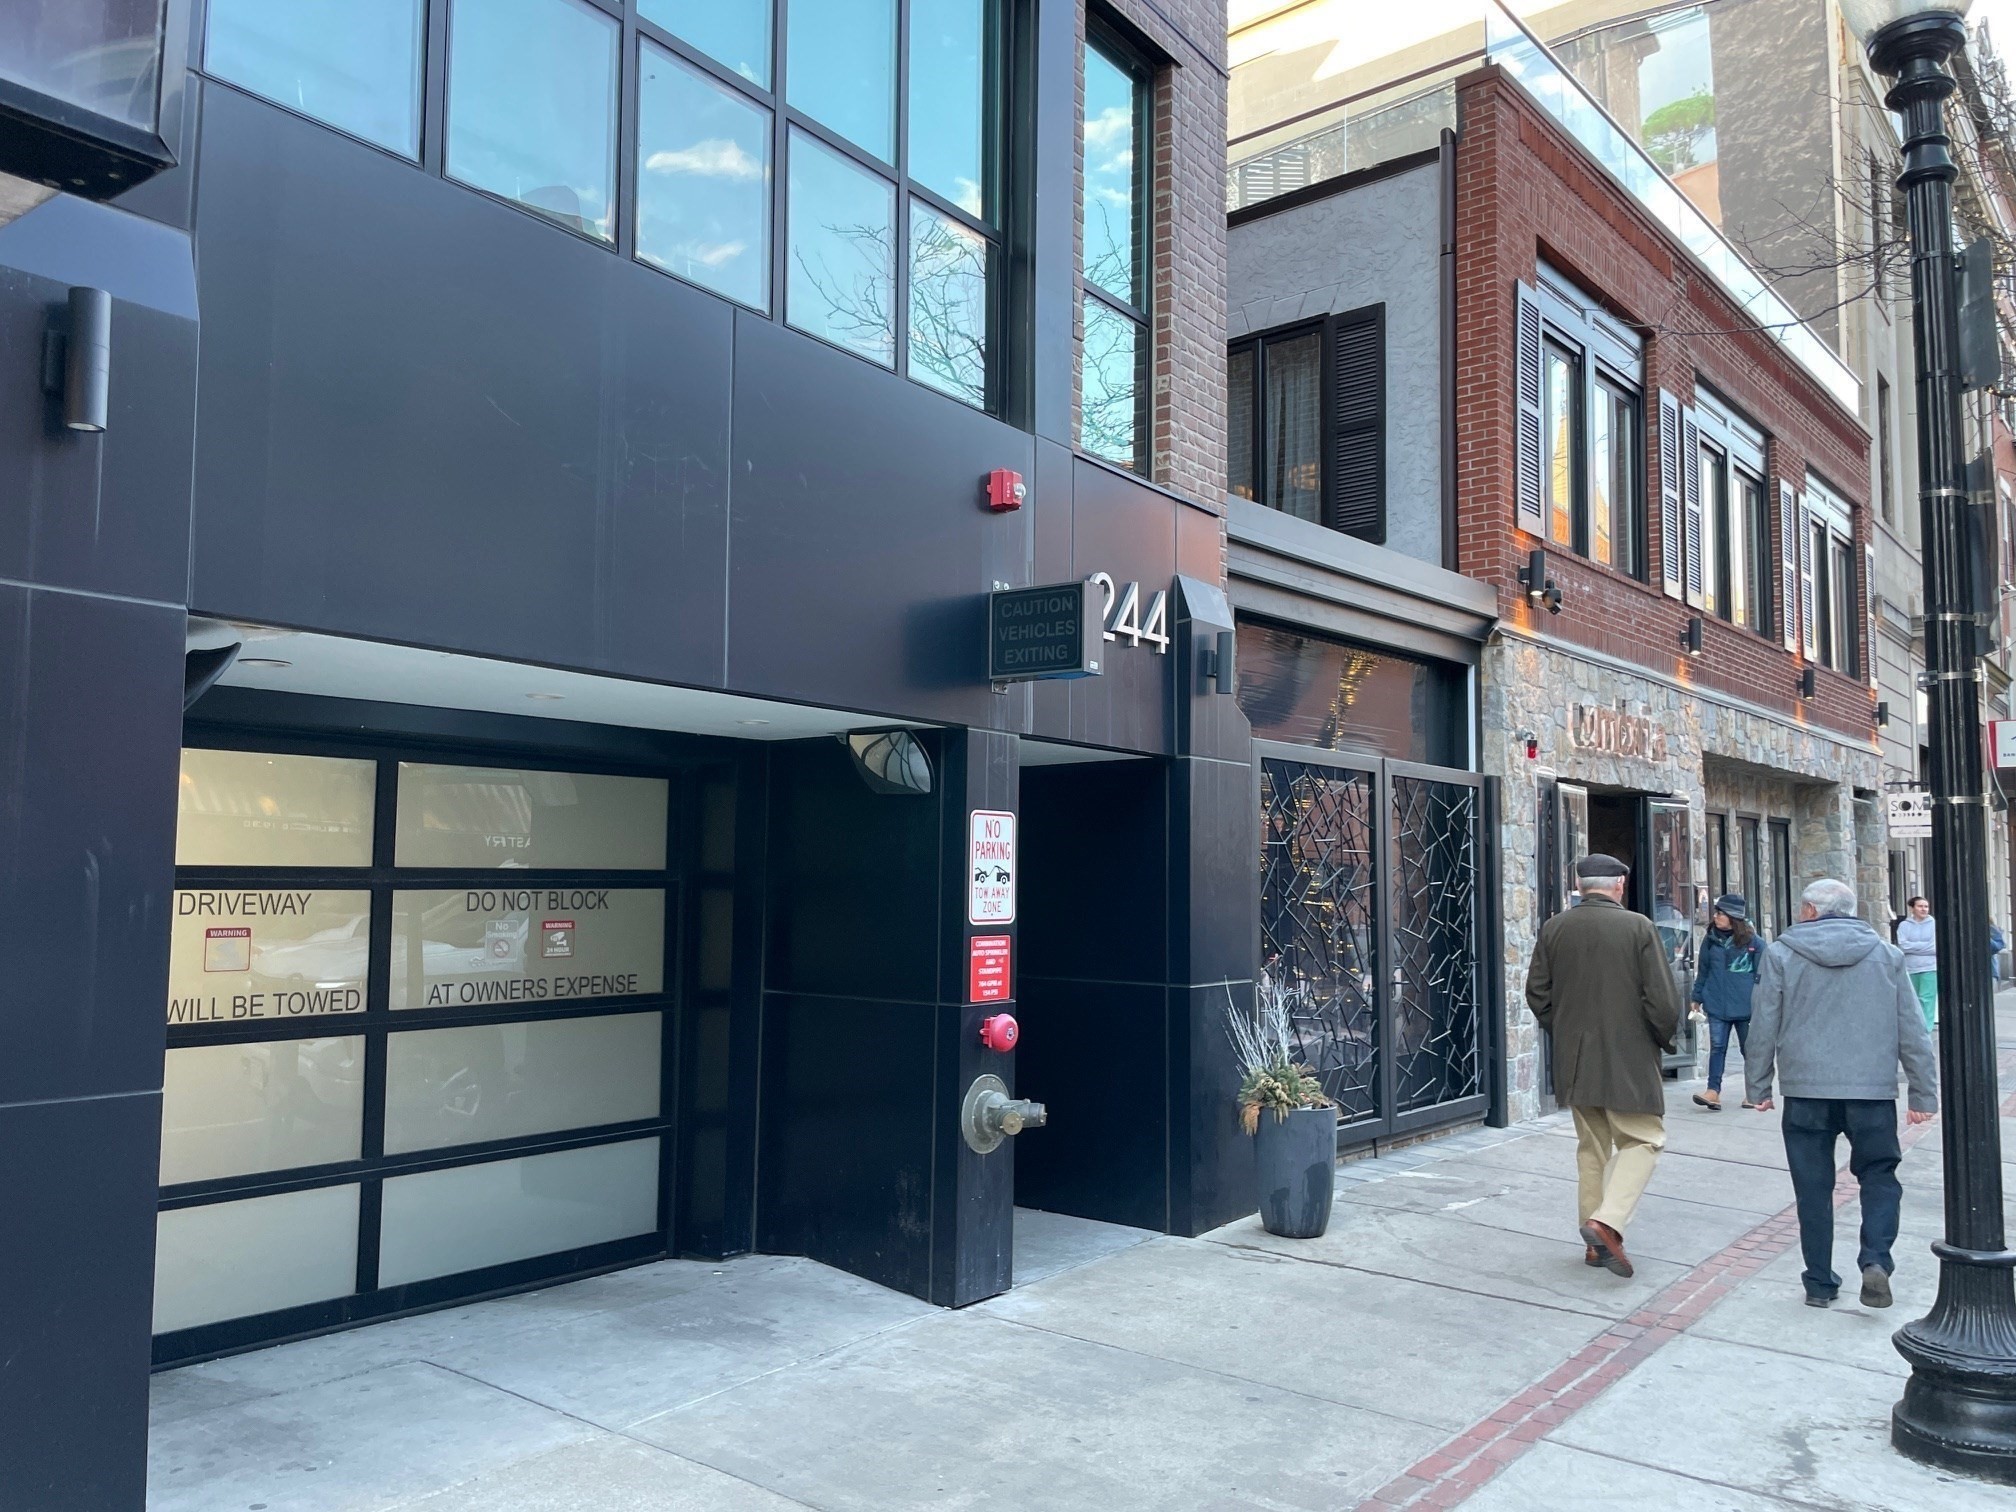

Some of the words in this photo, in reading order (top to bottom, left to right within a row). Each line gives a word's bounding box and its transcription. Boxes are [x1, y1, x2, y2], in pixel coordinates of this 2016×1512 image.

[1001, 596, 1074, 618] CAUTION
[1090, 571, 1169, 655] 244
[999, 619, 1076, 642] VEHICLES
[1004, 644, 1068, 665] EXITING
[985, 820, 1001, 839] NO
[975, 841, 1010, 860] PARKING
[466, 891, 496, 912] DO
[502, 890, 543, 911] NOT
[547, 890, 609, 911] BLOCK
[975, 887, 988, 899] TOW
[992, 887, 1010, 899] AWAY
[178, 892, 312, 916] DRIVEWAY
[983, 901, 1002, 913] ZONE
[210, 929, 248, 937] WARNING
[486, 930, 517, 939] Smoking
[495, 922, 509, 931] No
[428, 983, 454, 1005] AT
[460, 978, 548, 1003] OWNERS
[554, 973, 638, 997] EXPENSE
[167, 997, 224, 1023] WILL
[232, 994, 265, 1019] BE
[272, 989, 361, 1016] TOWED
